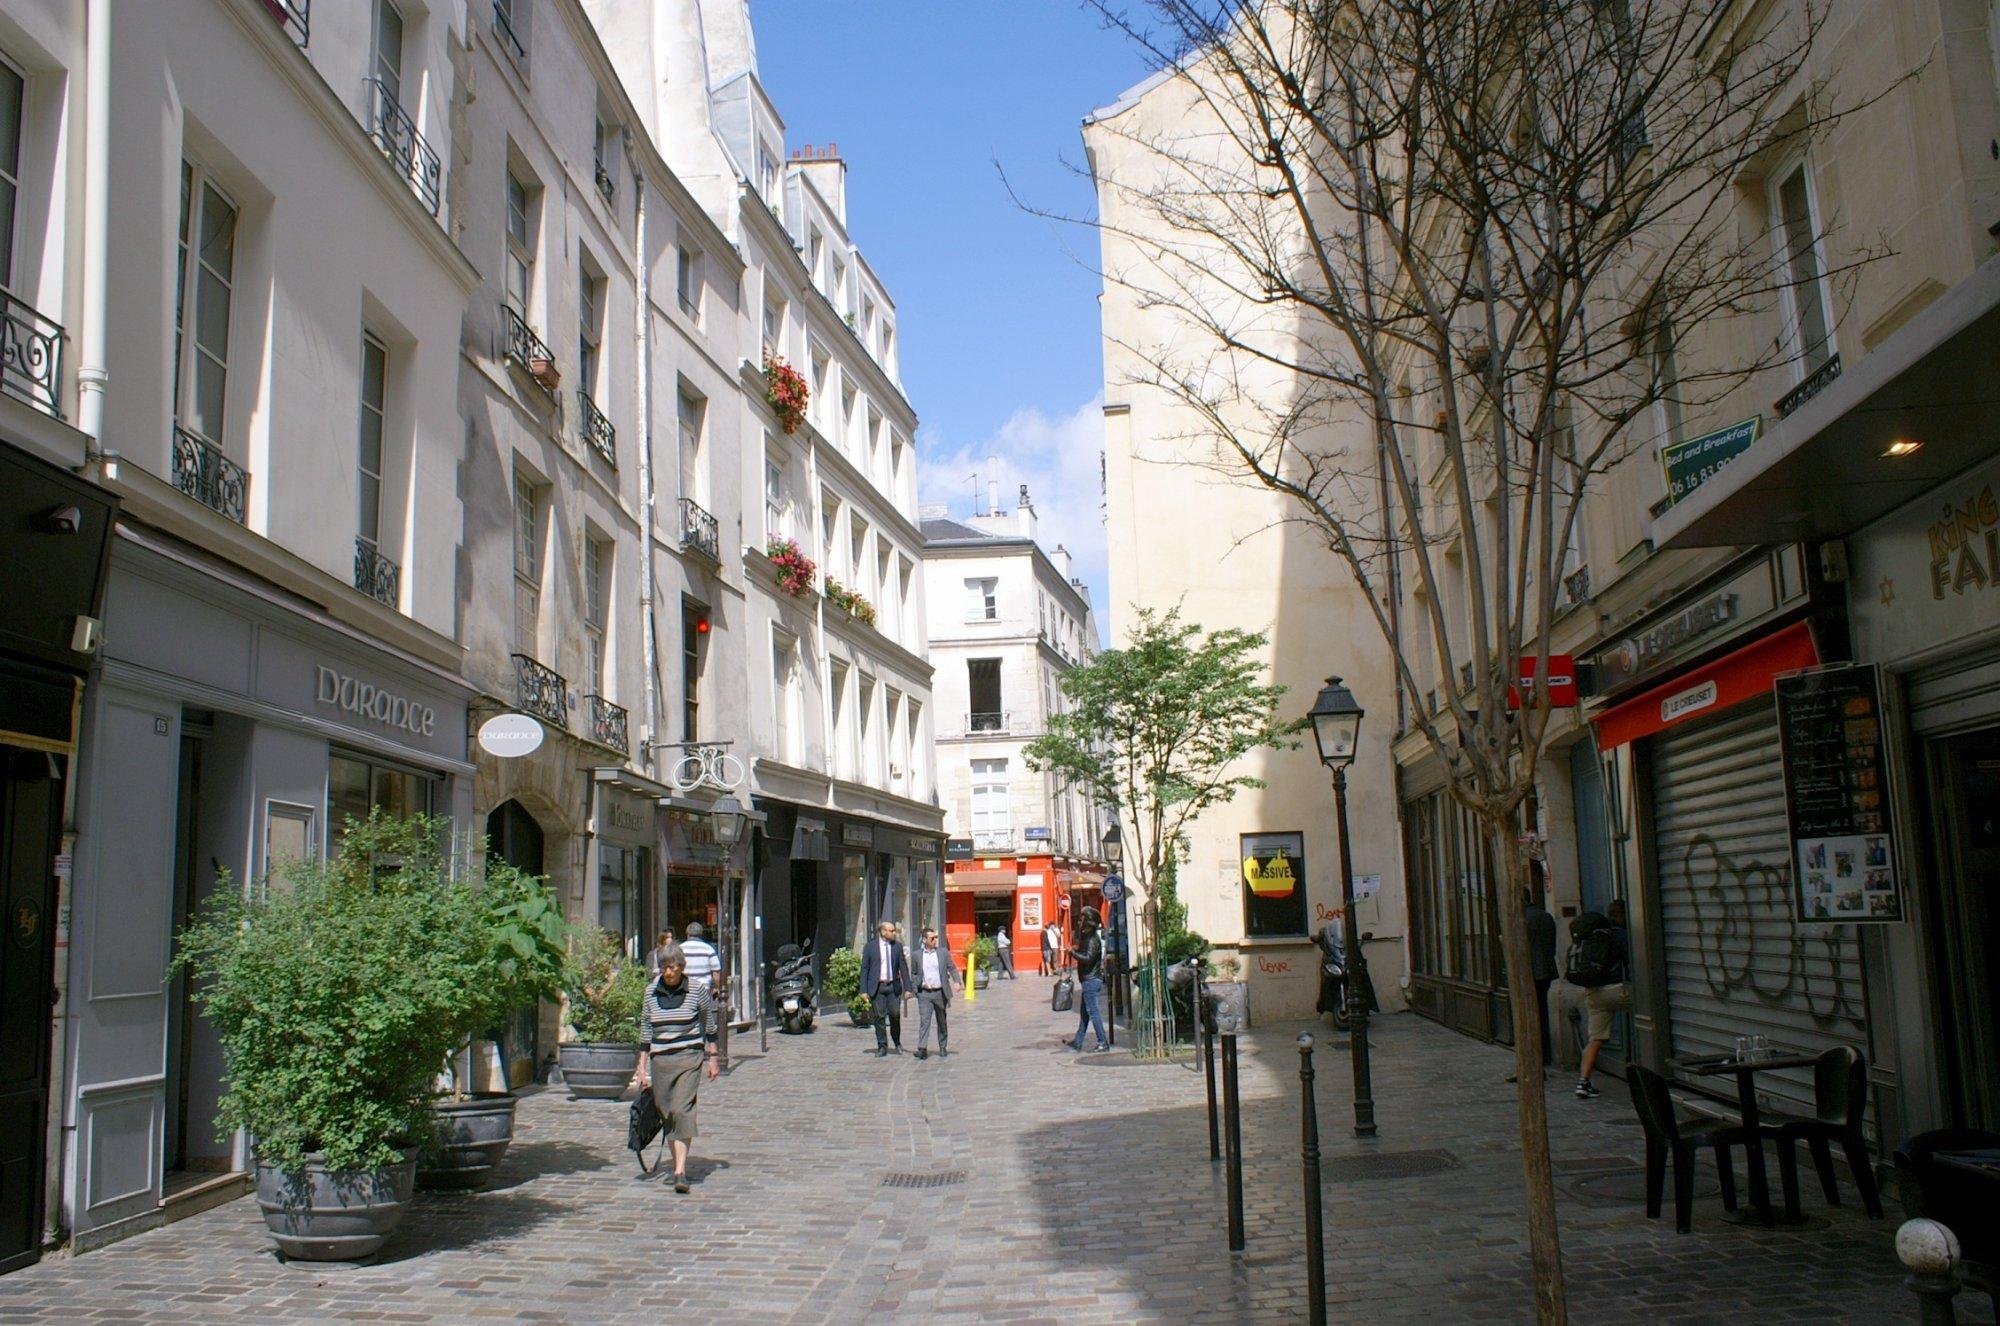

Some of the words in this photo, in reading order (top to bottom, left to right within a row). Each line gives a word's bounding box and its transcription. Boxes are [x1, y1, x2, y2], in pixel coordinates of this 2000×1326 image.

[1666, 450, 1683, 467] Bed
[1684, 443, 1702, 459] and
[1704, 424, 1755, 451] Breakfast
[1671, 479, 1684, 496] 06
[1686, 472, 1698, 489] 16
[316, 664, 435, 738] DURANCE
[1671, 701, 1679, 712] LE
[1680, 687, 1711, 708] CREUSET
[1258, 955, 1291, 973] love
